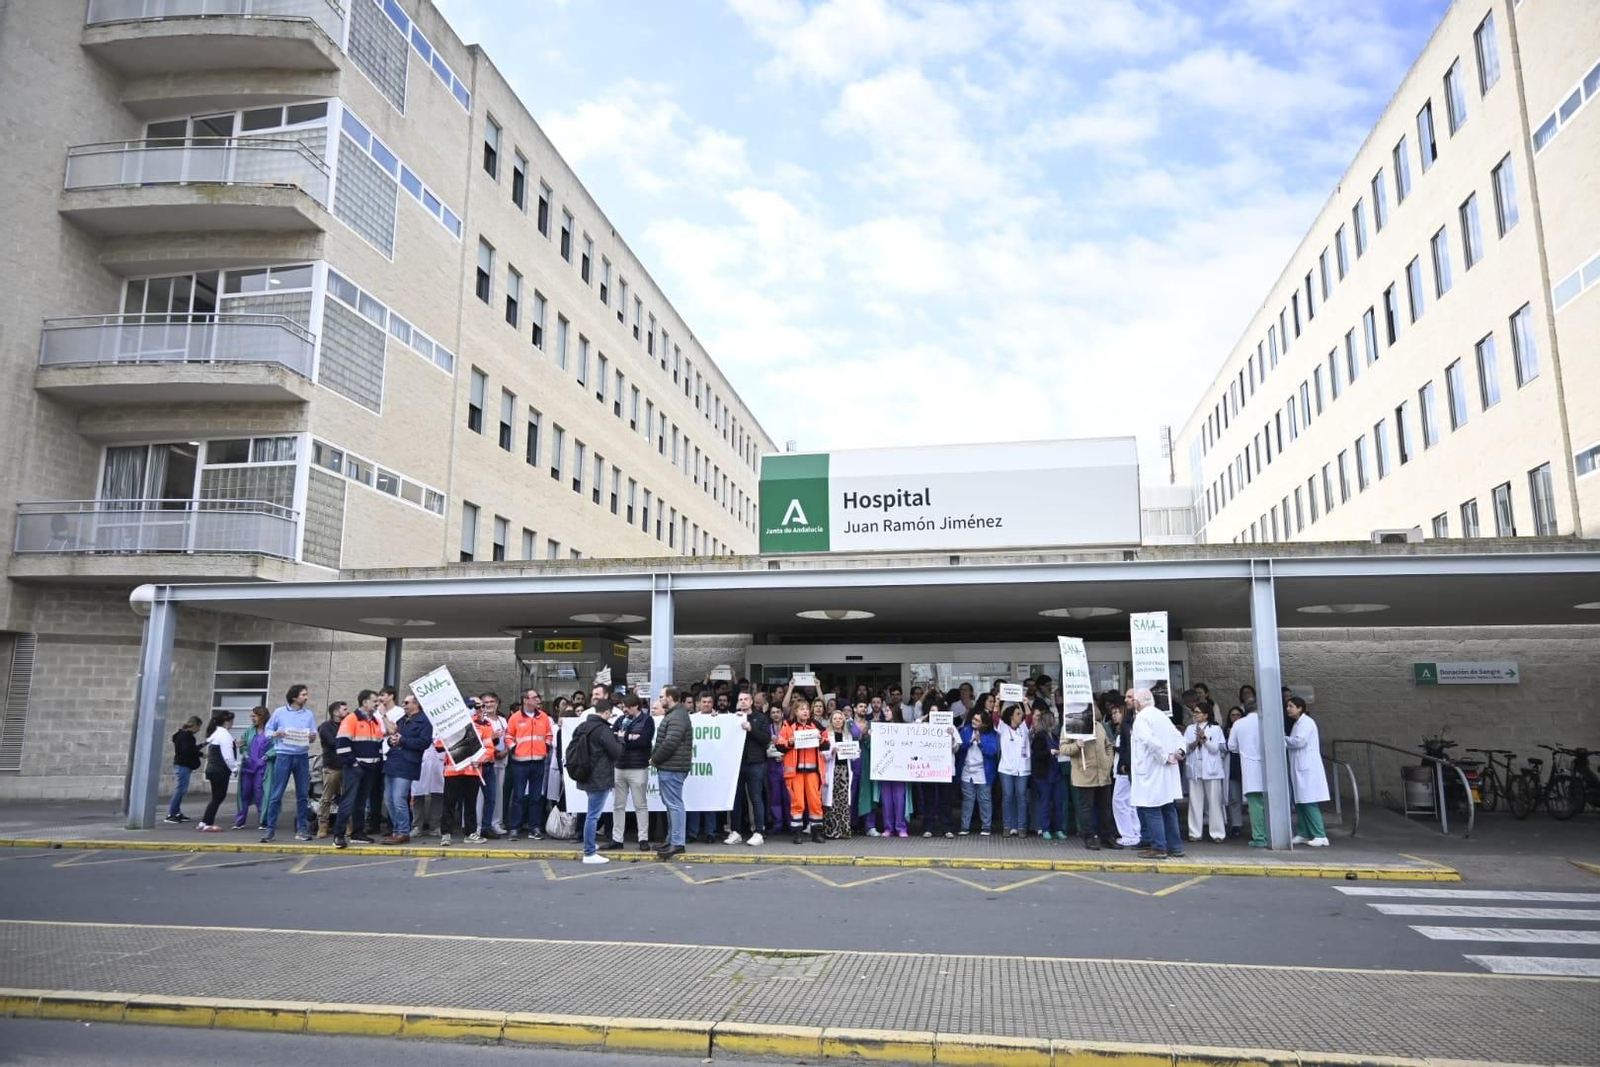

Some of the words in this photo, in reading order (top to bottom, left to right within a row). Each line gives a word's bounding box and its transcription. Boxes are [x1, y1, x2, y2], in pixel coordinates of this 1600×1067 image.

[843, 487, 932, 512] Hospital
[843, 521, 879, 534] Juan
[883, 516, 935, 532] Ramón
[939, 513, 1003, 531] Jiménez
[548, 642, 578, 650] ONCE
[1440, 668, 1469, 676] Donación
[1479, 668, 1501, 677] Sangre
[429, 696, 460, 718] HUELVA
[692, 726, 721, 740] OPIO
[880, 724, 899, 735] SIN
[884, 739, 895, 747] NO
